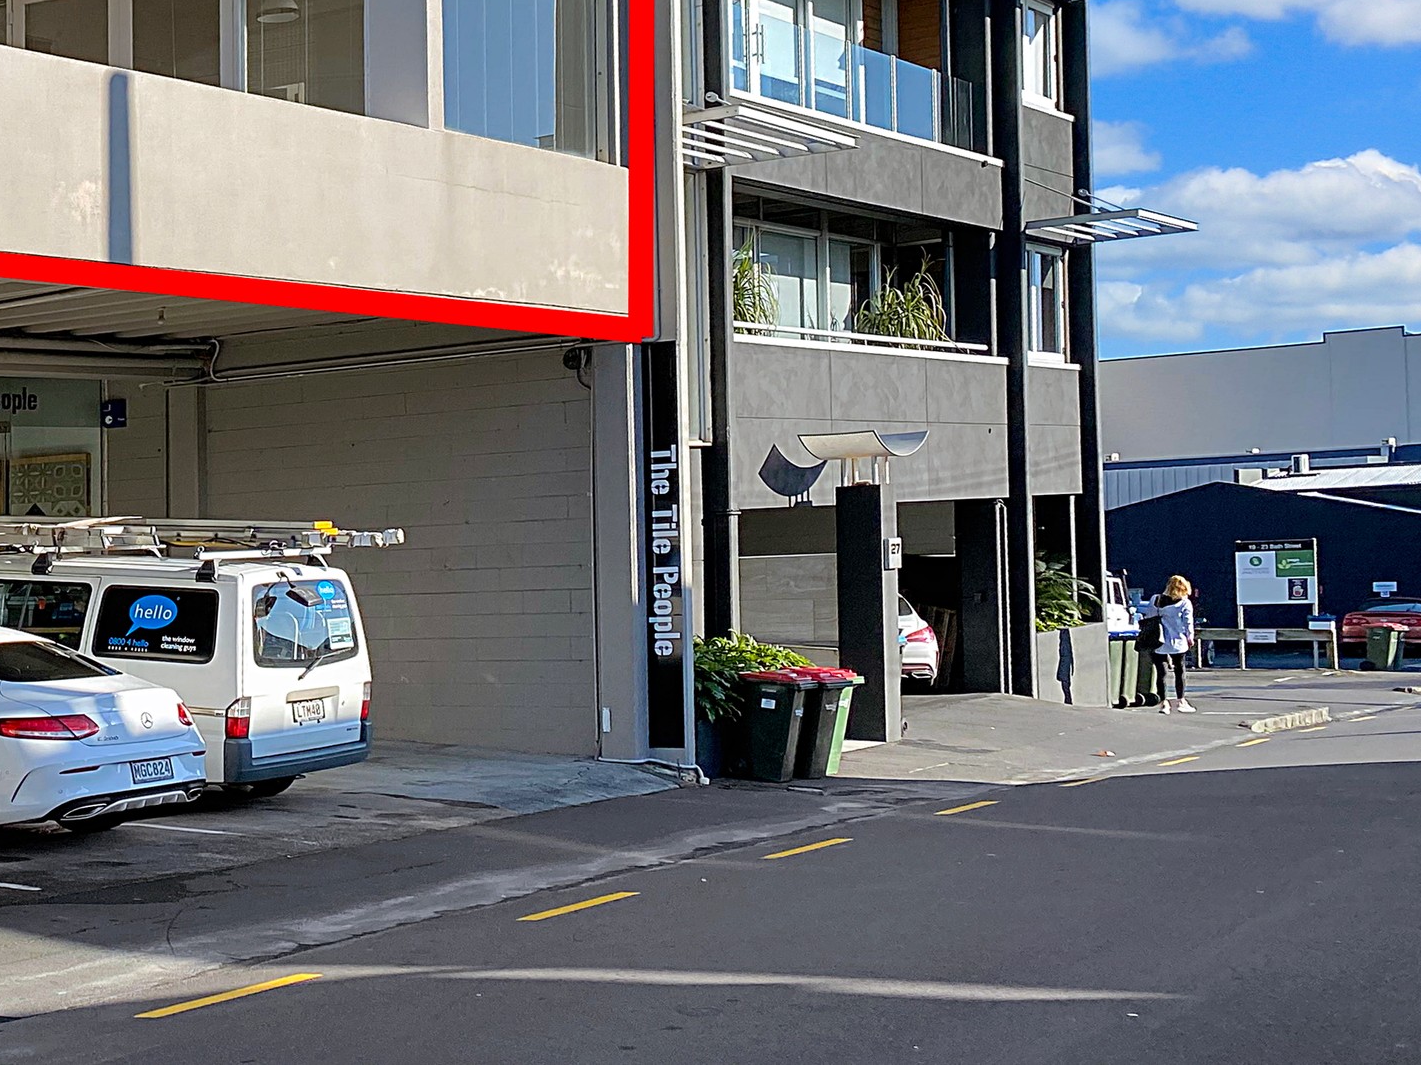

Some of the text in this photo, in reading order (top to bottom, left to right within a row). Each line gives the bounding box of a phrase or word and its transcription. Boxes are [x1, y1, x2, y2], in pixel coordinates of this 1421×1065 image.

[648, 444, 681, 657] The Tile People
[890, 543, 901, 554] 27
[134, 603, 173, 620] hello
[126, 638, 132, 646] 4
[132, 638, 150, 648] hello
[172, 636, 196, 644] window
[160, 642, 197, 652] cleaning guys
